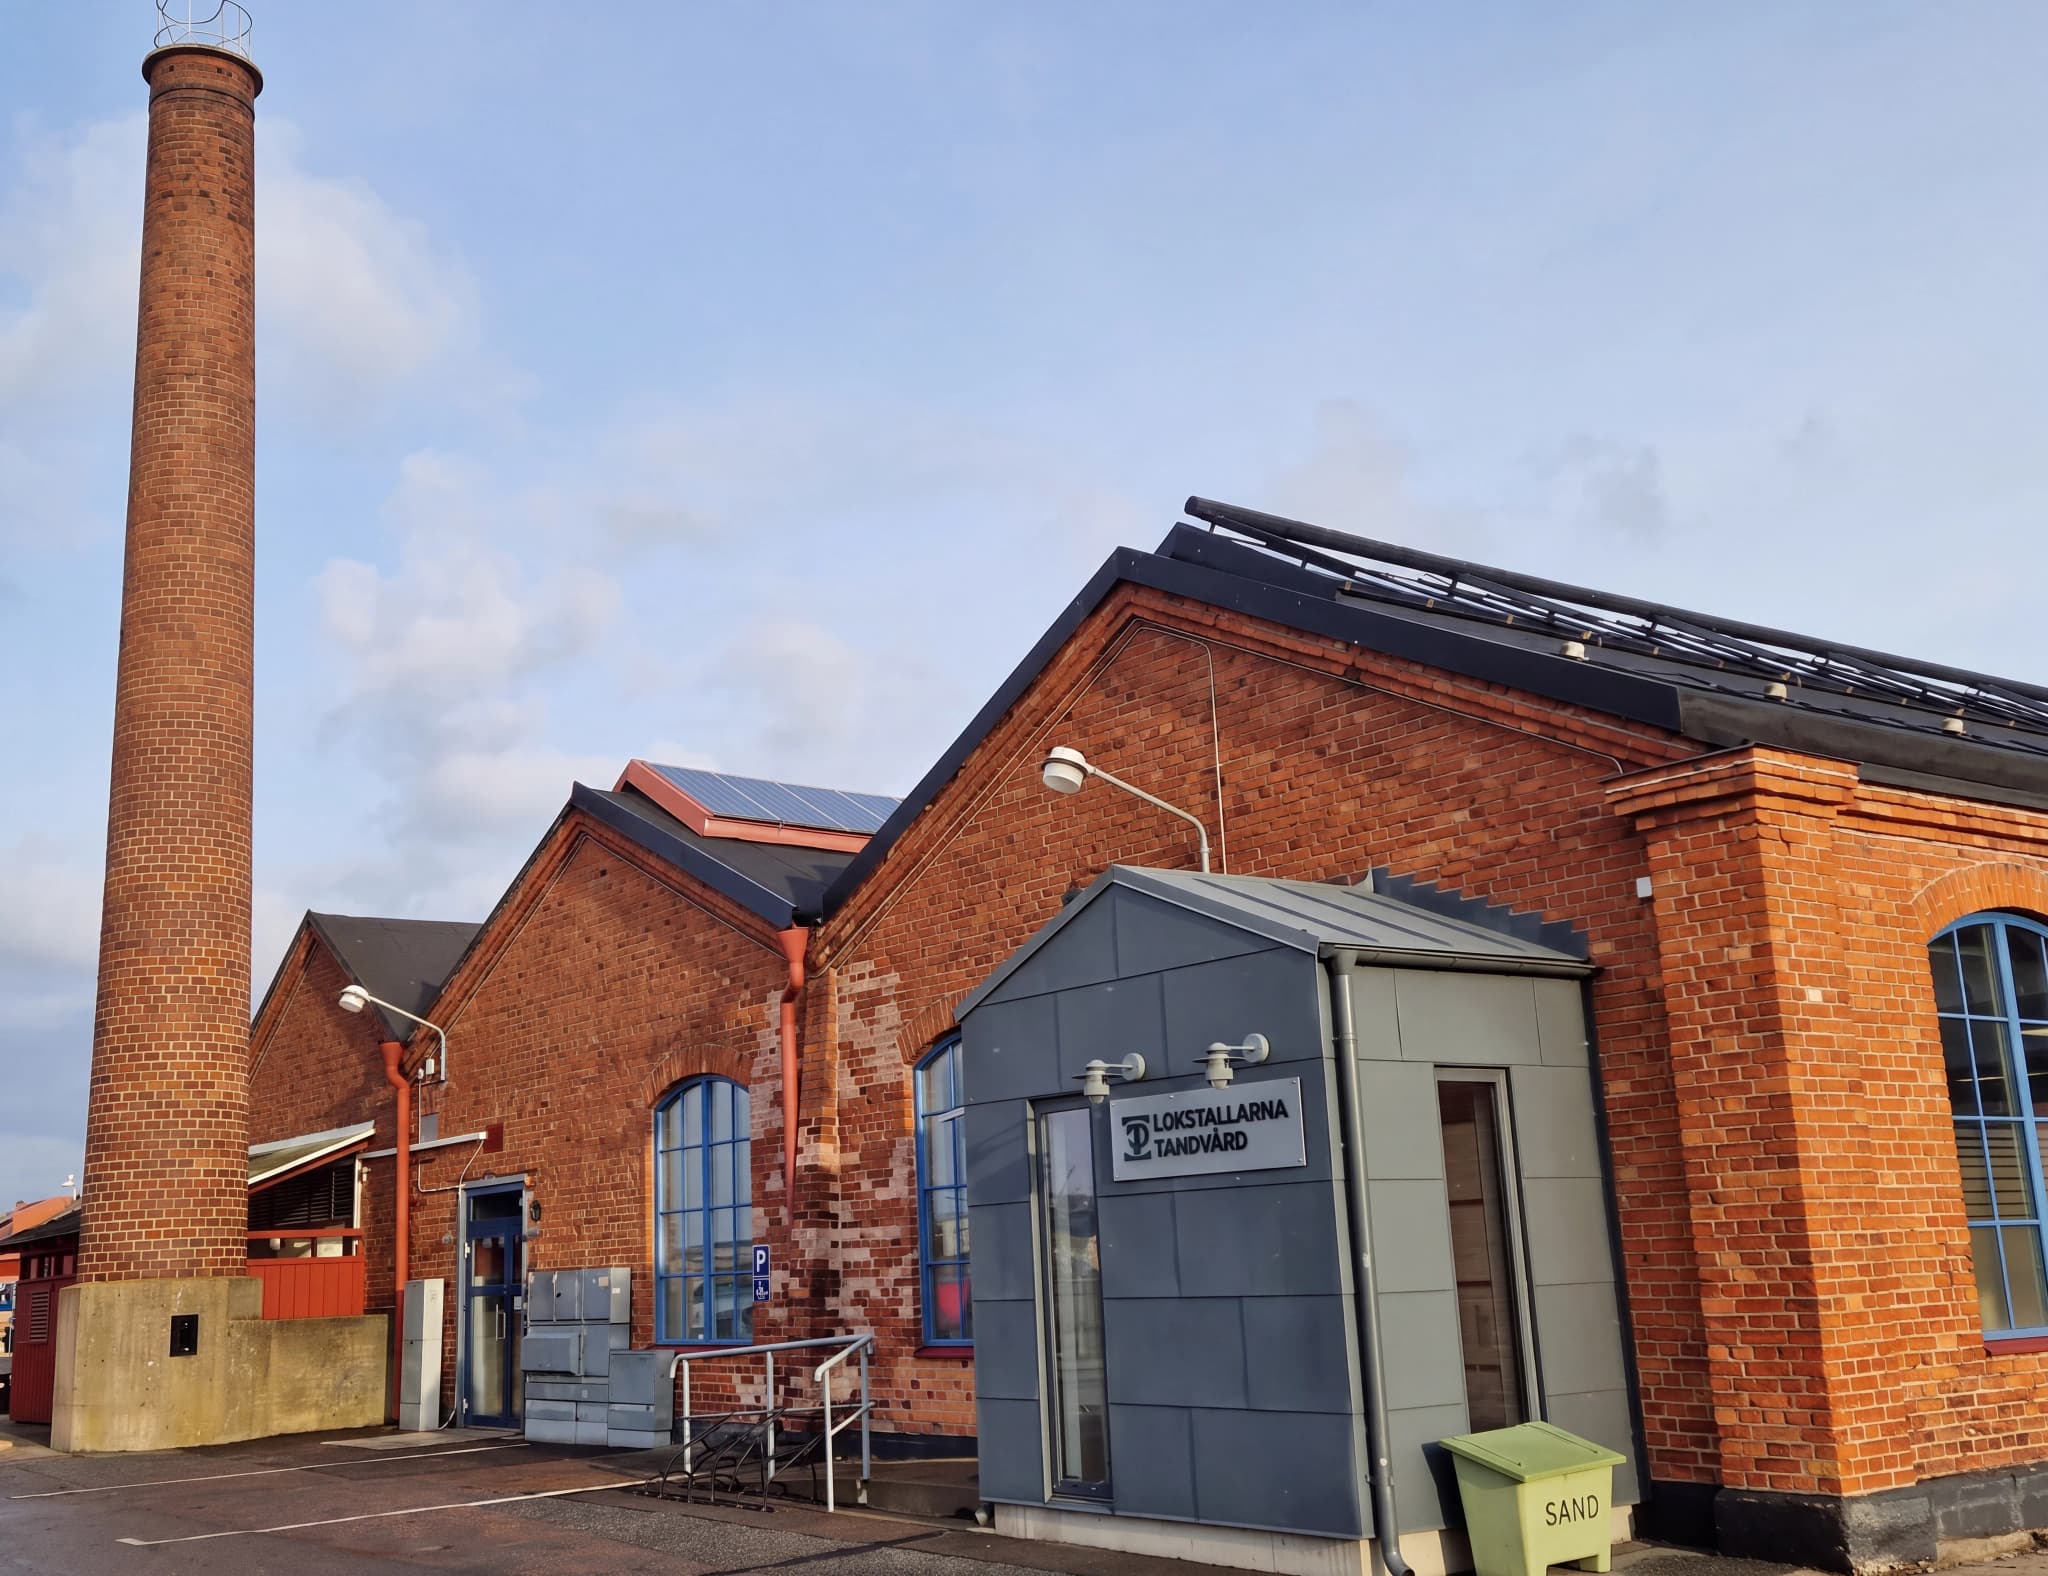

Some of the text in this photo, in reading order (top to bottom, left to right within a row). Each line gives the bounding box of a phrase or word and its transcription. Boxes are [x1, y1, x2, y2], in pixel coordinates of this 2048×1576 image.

[1153, 1099, 1289, 1132] LOKSTALLARNA
[1154, 1127, 1248, 1158] TANDVÅRD
[756, 1249, 767, 1273] P
[1545, 1494, 1599, 1526] SAND
